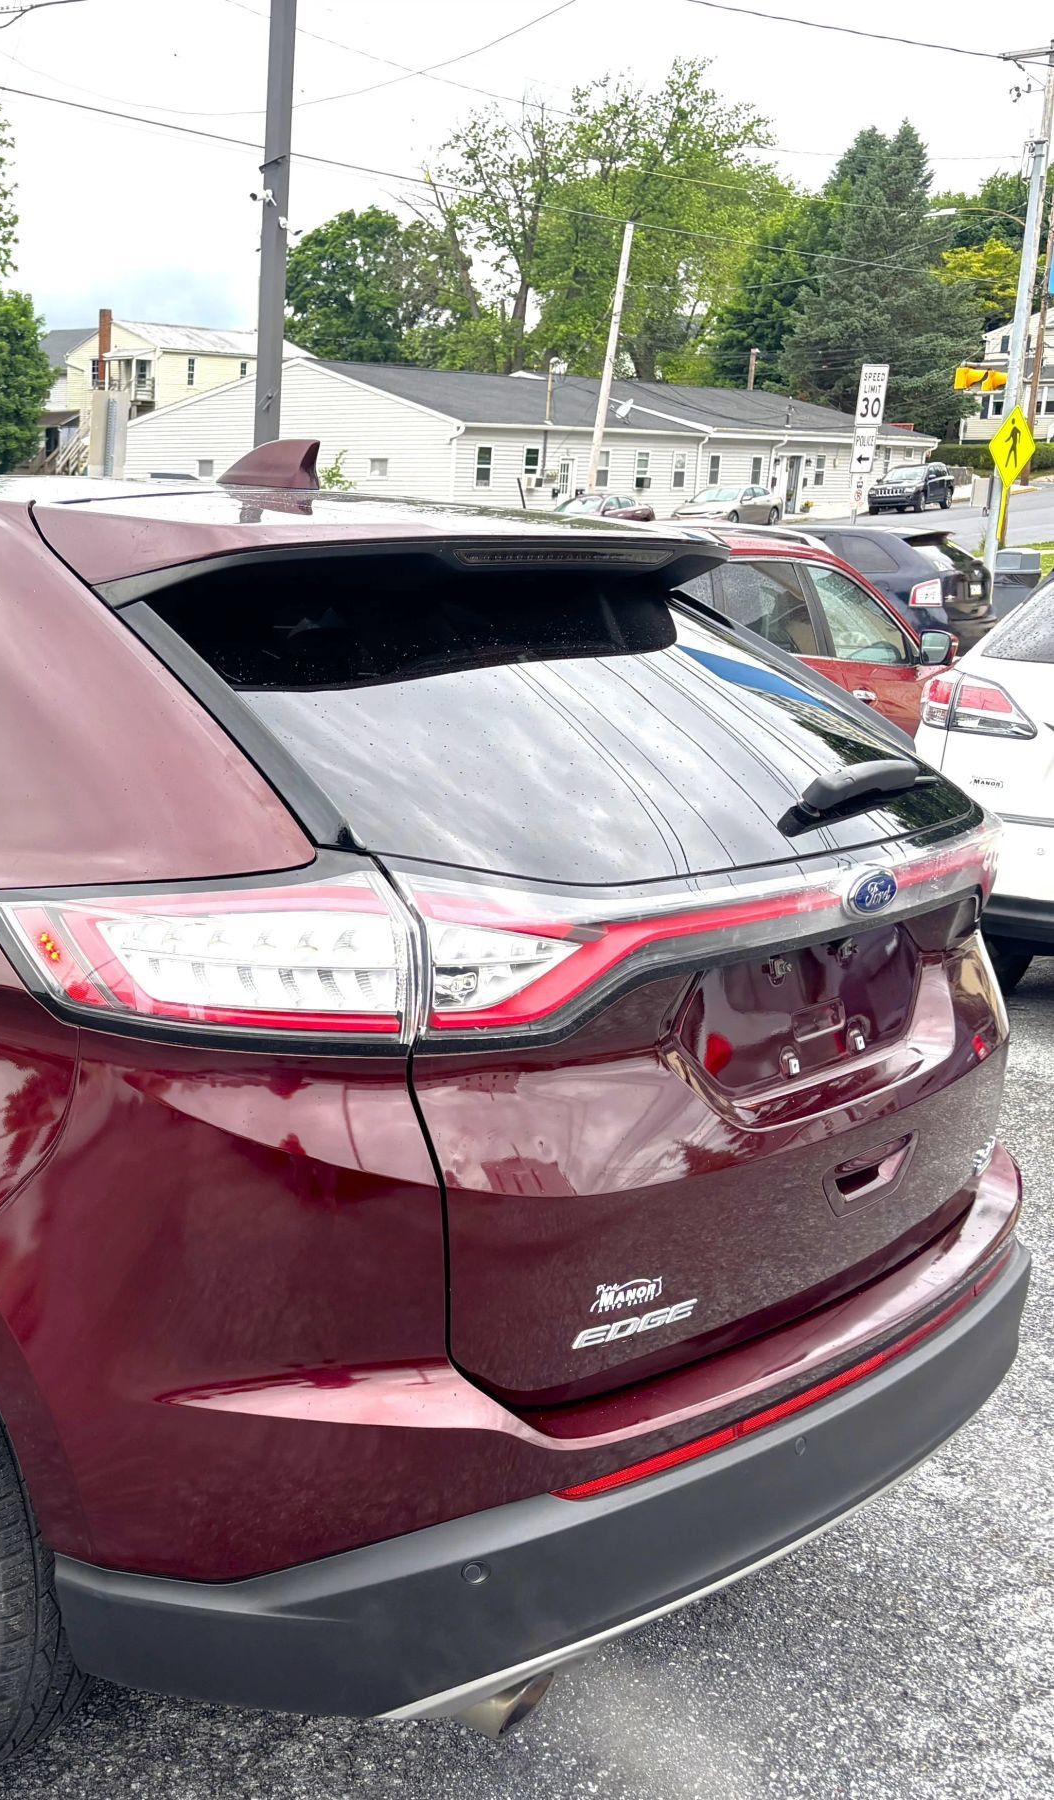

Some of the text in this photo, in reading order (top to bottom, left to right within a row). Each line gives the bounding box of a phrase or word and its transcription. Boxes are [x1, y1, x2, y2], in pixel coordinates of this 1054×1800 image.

[863, 372, 886, 382] SPEED
[863, 384, 882, 394] LIMIT
[859, 397, 881, 418] 30
[855, 435, 875, 447] POLICE
[973, 778, 1001, 789] MANOR
[598, 1283, 657, 1307] MANOR
[571, 1298, 698, 1350] EDGE
